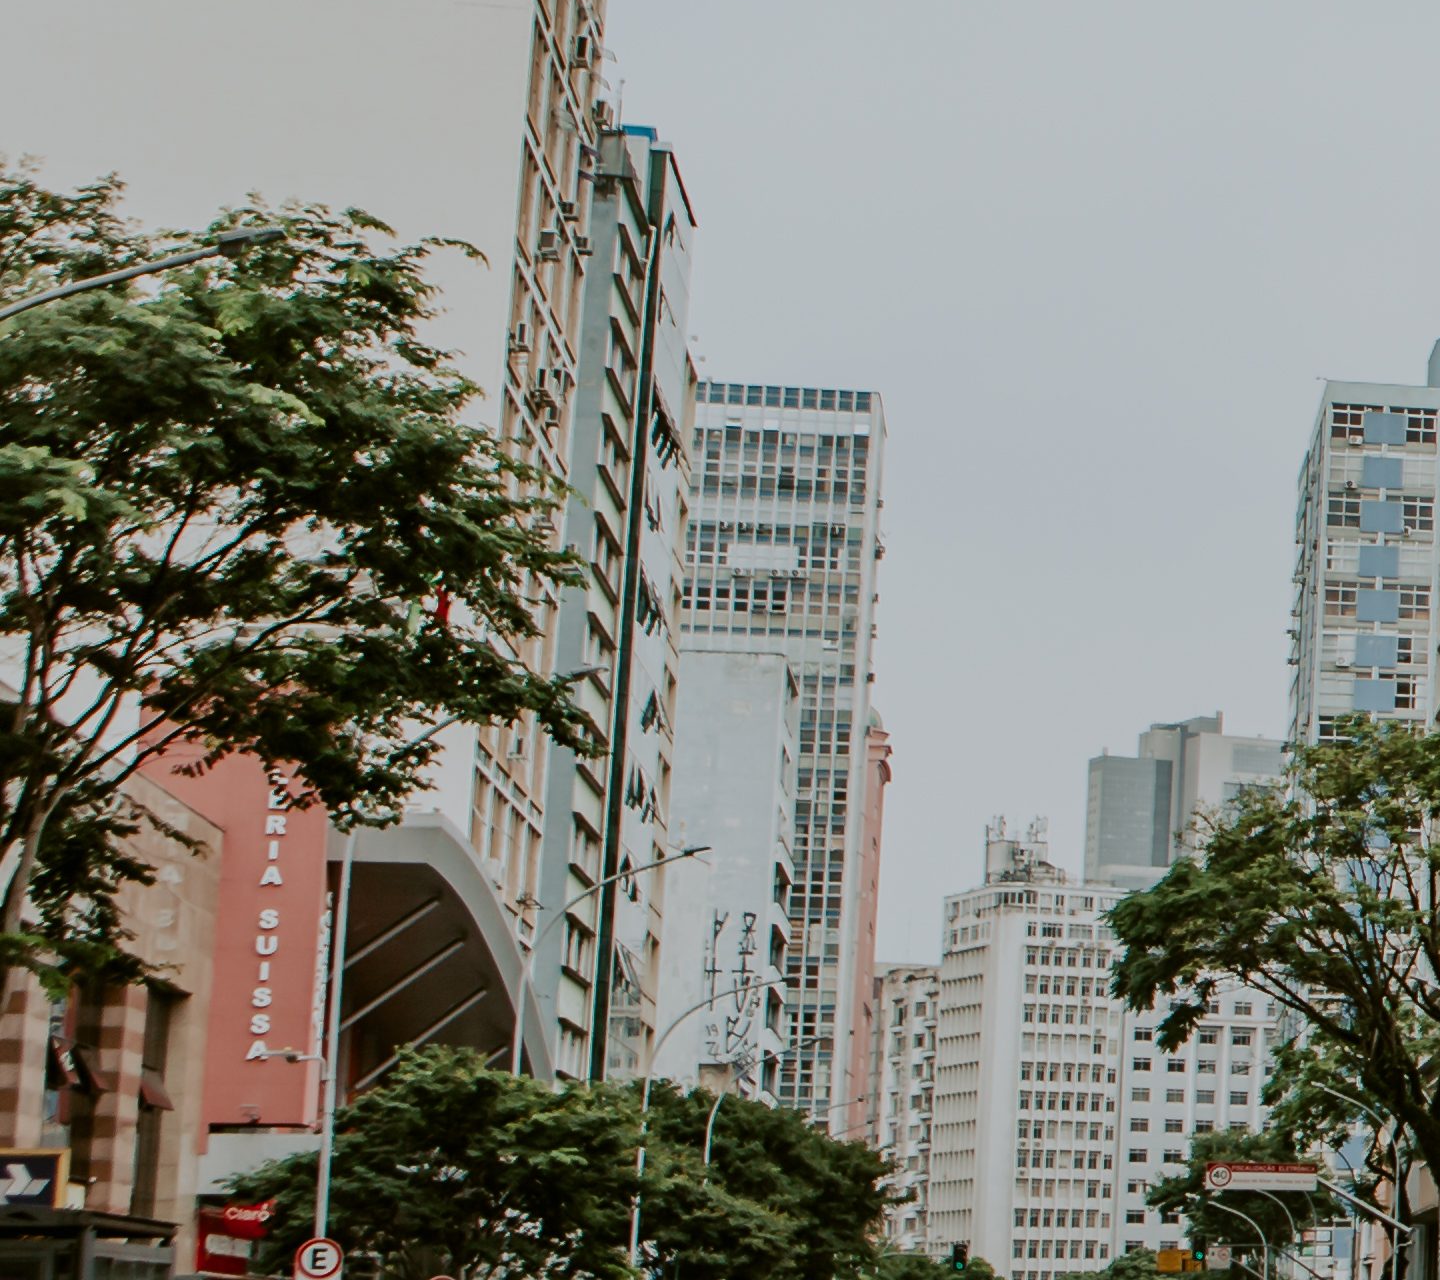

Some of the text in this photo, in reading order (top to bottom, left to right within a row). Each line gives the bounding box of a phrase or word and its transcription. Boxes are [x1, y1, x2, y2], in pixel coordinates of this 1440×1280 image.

[245, 908, 279, 1061] SUISSA
[1213, 1170, 1228, 1179] 40
[225, 1205, 270, 1221] Claro
[312, 1248, 328, 1270] E
